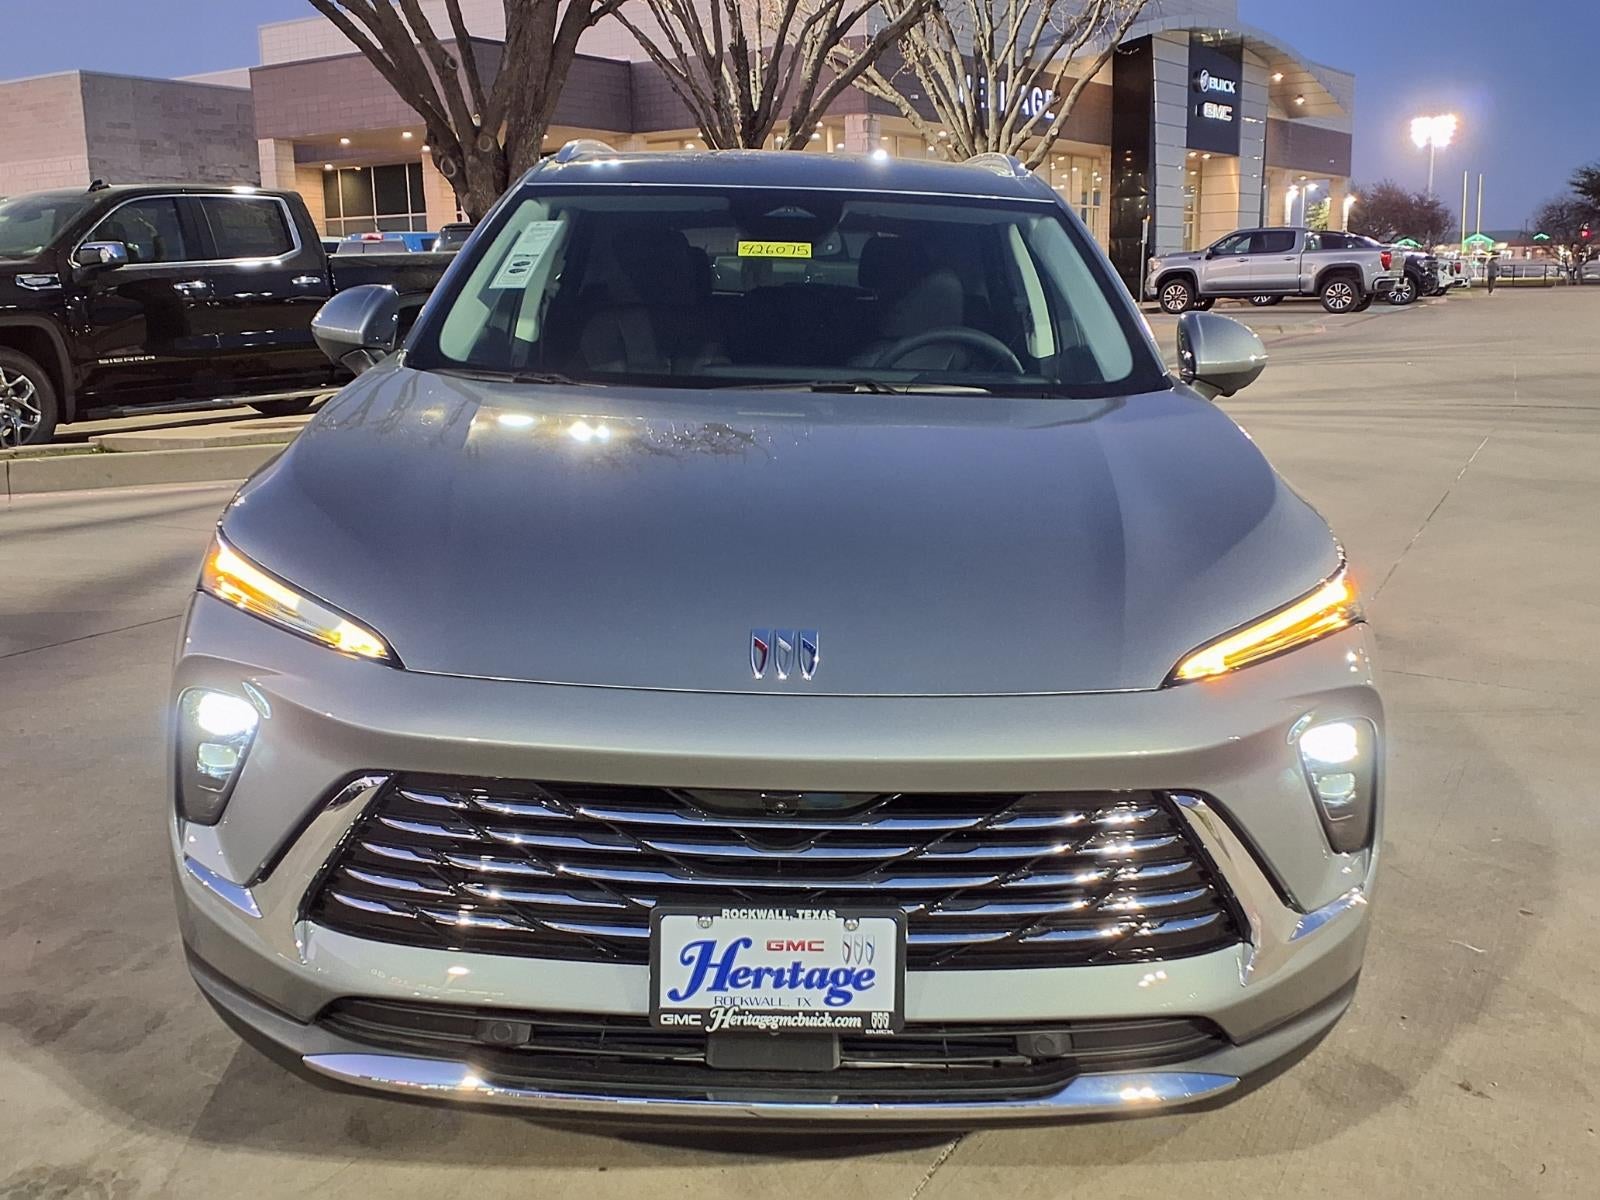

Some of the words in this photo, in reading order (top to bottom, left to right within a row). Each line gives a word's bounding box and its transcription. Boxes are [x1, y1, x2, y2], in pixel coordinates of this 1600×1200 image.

[1209, 77, 1236, 94] BUICK
[1203, 102, 1233, 121] GMC
[796, 909, 837, 920] TEXAS
[766, 940, 825, 952] GMC
[667, 937, 876, 1007] Heritage
[797, 997, 812, 1007] TX
[660, 1014, 701, 1026] GMC
[705, 1007, 862, 1032] Heritagegmcbuick.com
